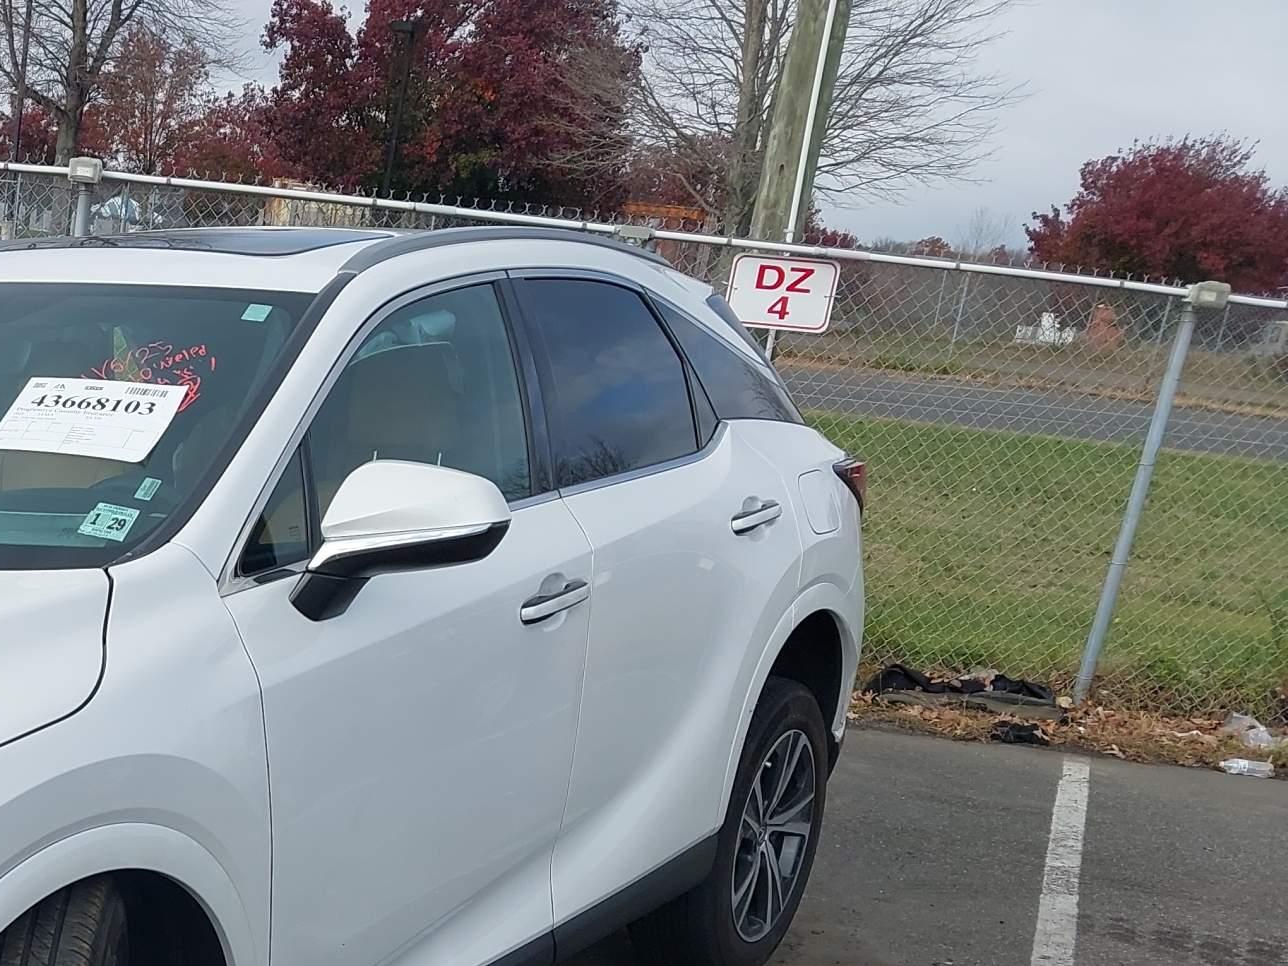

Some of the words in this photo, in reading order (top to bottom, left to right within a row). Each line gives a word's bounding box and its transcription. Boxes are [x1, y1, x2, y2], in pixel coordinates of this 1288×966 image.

[755, 264, 815, 294] DZ
[767, 296, 790, 320] 4
[31, 394, 157, 416] 43668103
[90, 513, 102, 526] 1
[106, 517, 127, 532] 29
